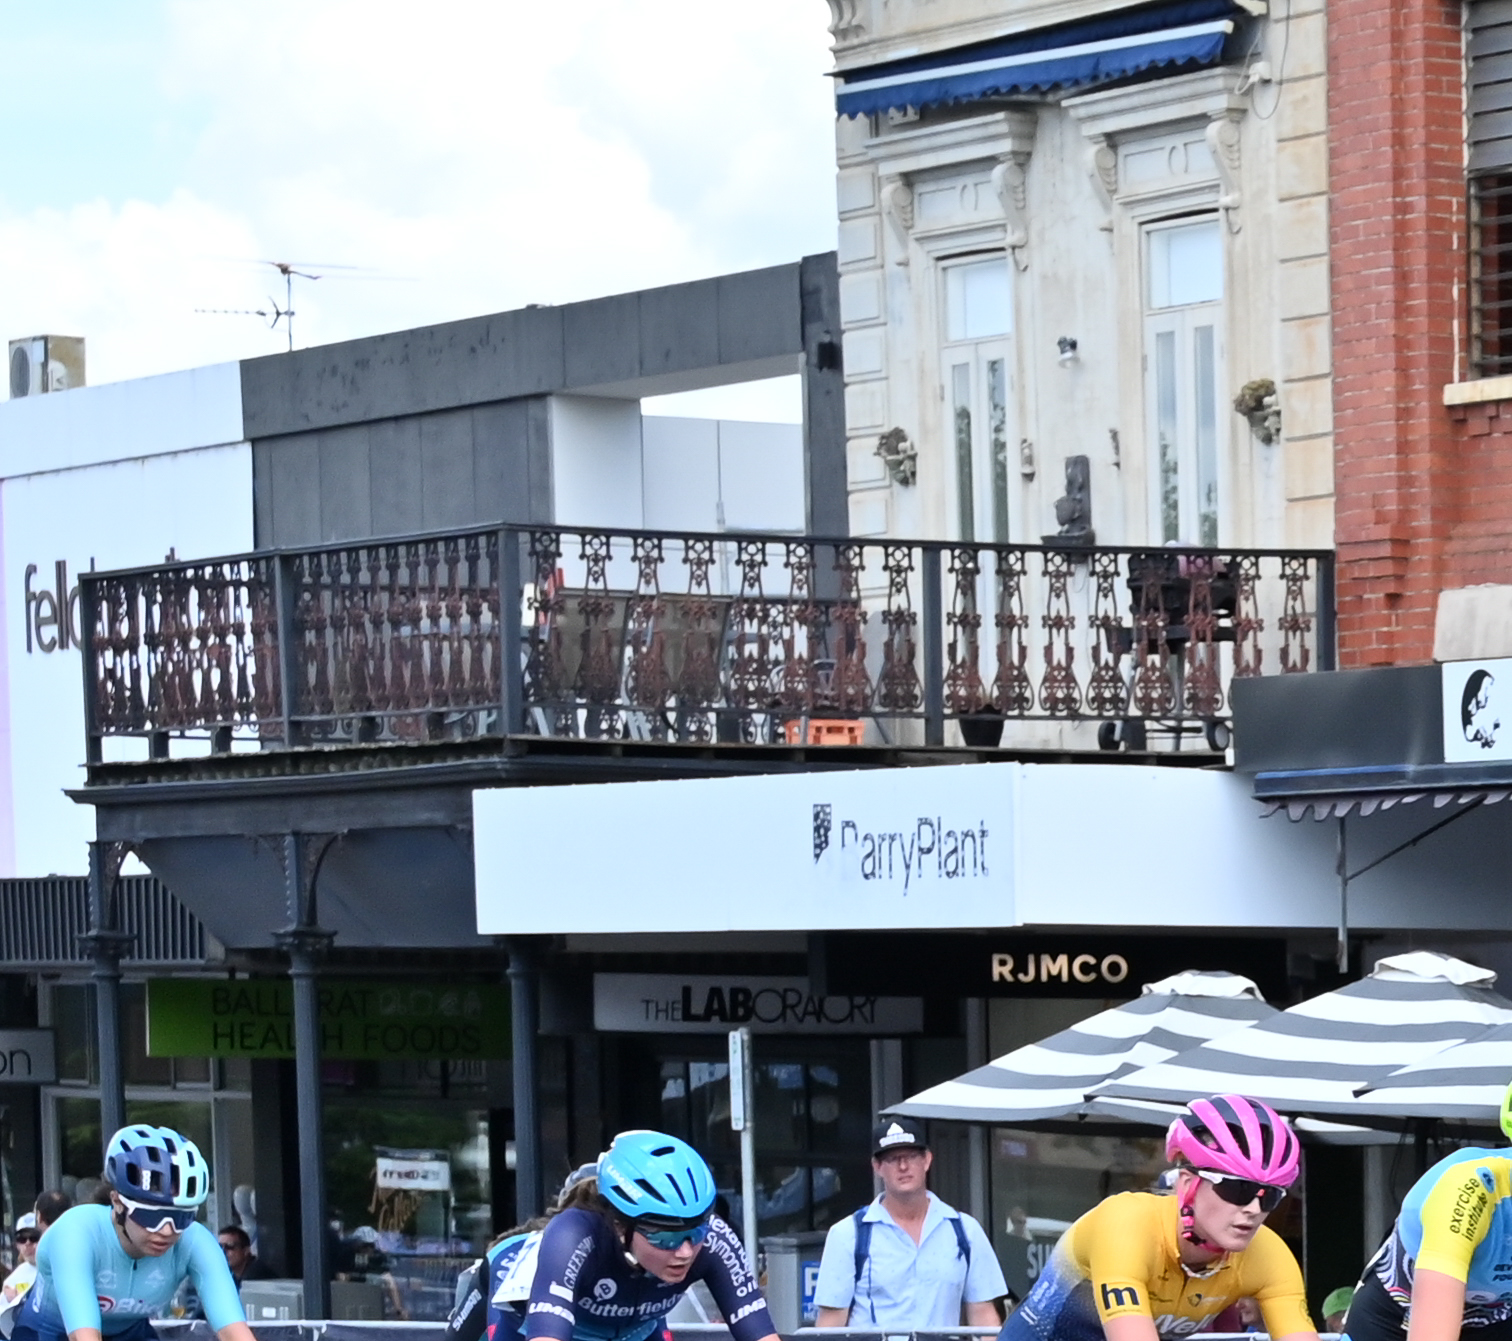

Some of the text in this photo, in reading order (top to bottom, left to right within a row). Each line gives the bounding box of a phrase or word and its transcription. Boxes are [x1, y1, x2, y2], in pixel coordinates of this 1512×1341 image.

[991, 953, 1128, 984] RJMCO
[211, 986, 371, 1018] BALLRAT
[641, 998, 682, 1022] THE
[211, 1021, 484, 1055] HEALH FOODS
[1449, 1177, 1480, 1234] exercise
